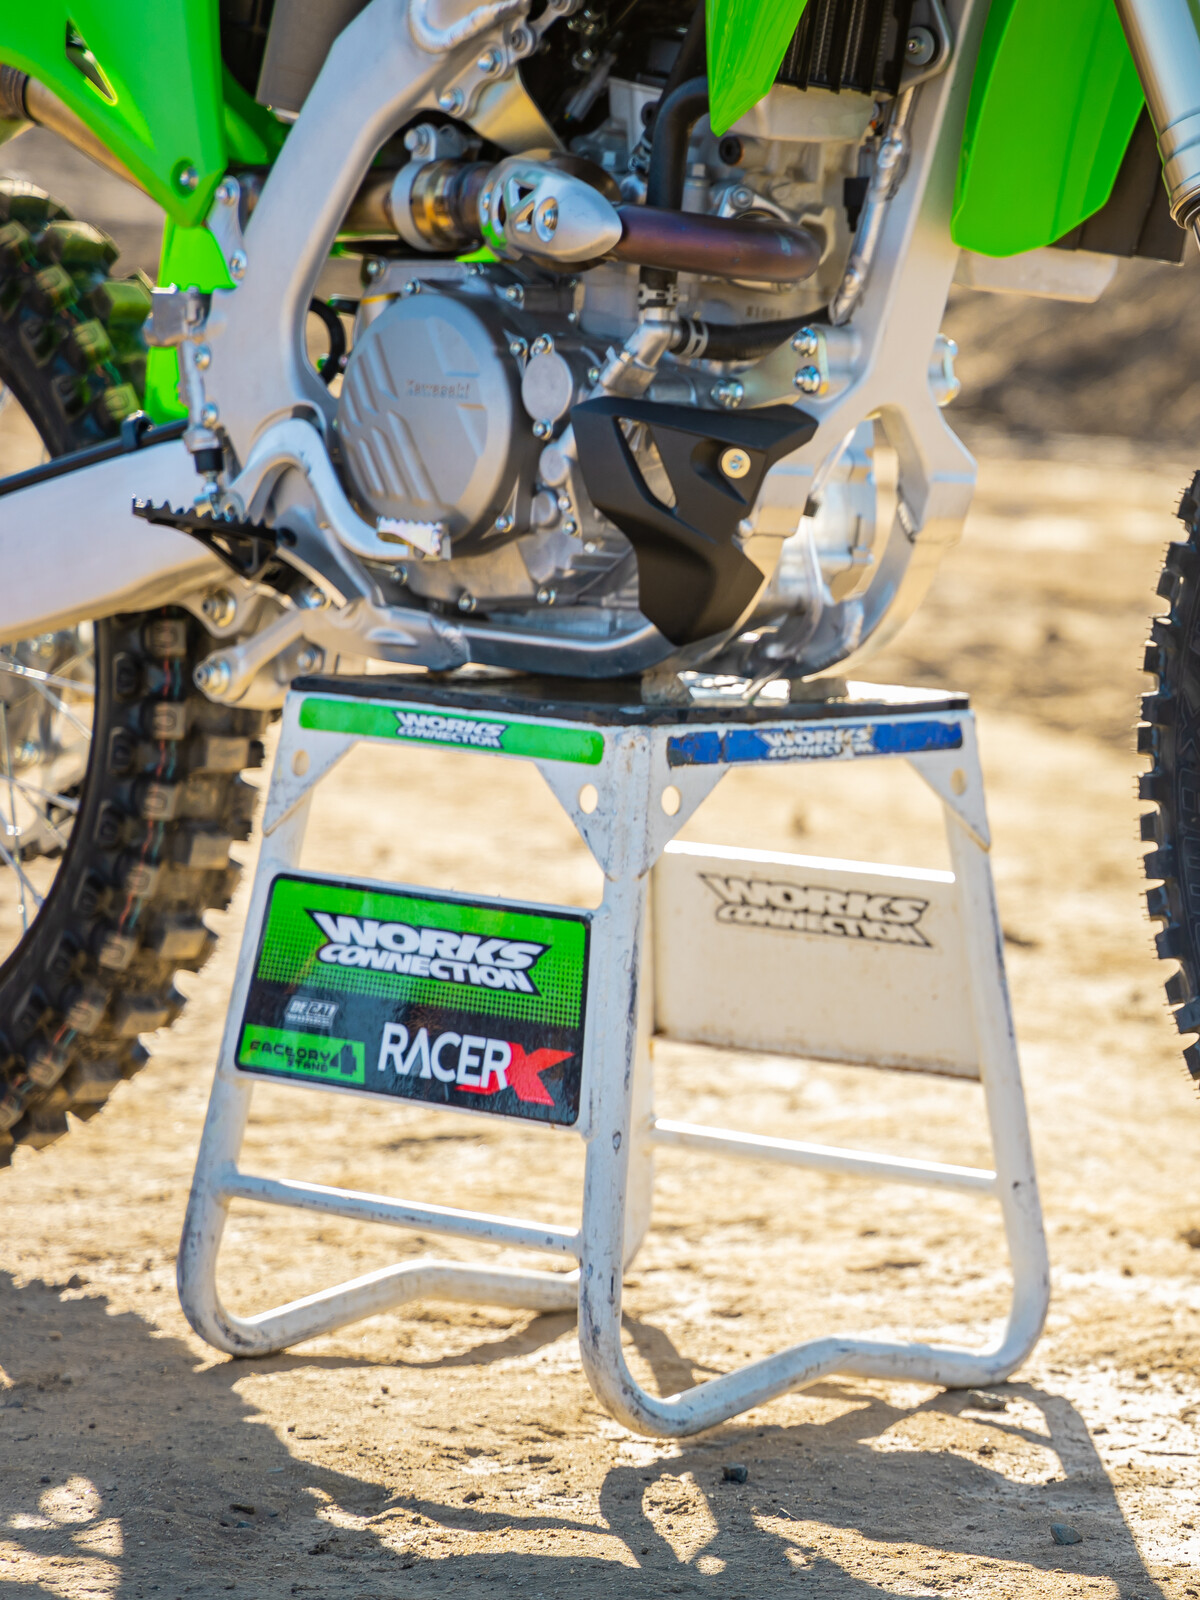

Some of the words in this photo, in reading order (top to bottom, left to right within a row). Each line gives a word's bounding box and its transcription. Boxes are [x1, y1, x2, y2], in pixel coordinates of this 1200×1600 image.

[394, 710, 508, 737] WORKS
[397, 727, 502, 748] CONNECTION
[761, 728, 872, 747] WORKS
[698, 872, 930, 926] WORKS
[716, 902, 933, 947] CONNECTION
[312, 911, 545, 970] WORKS
[318, 943, 535, 993] CONNECTION
[250, 1040, 331, 1061] FACTORY
[287, 1054, 329, 1073] STAND
